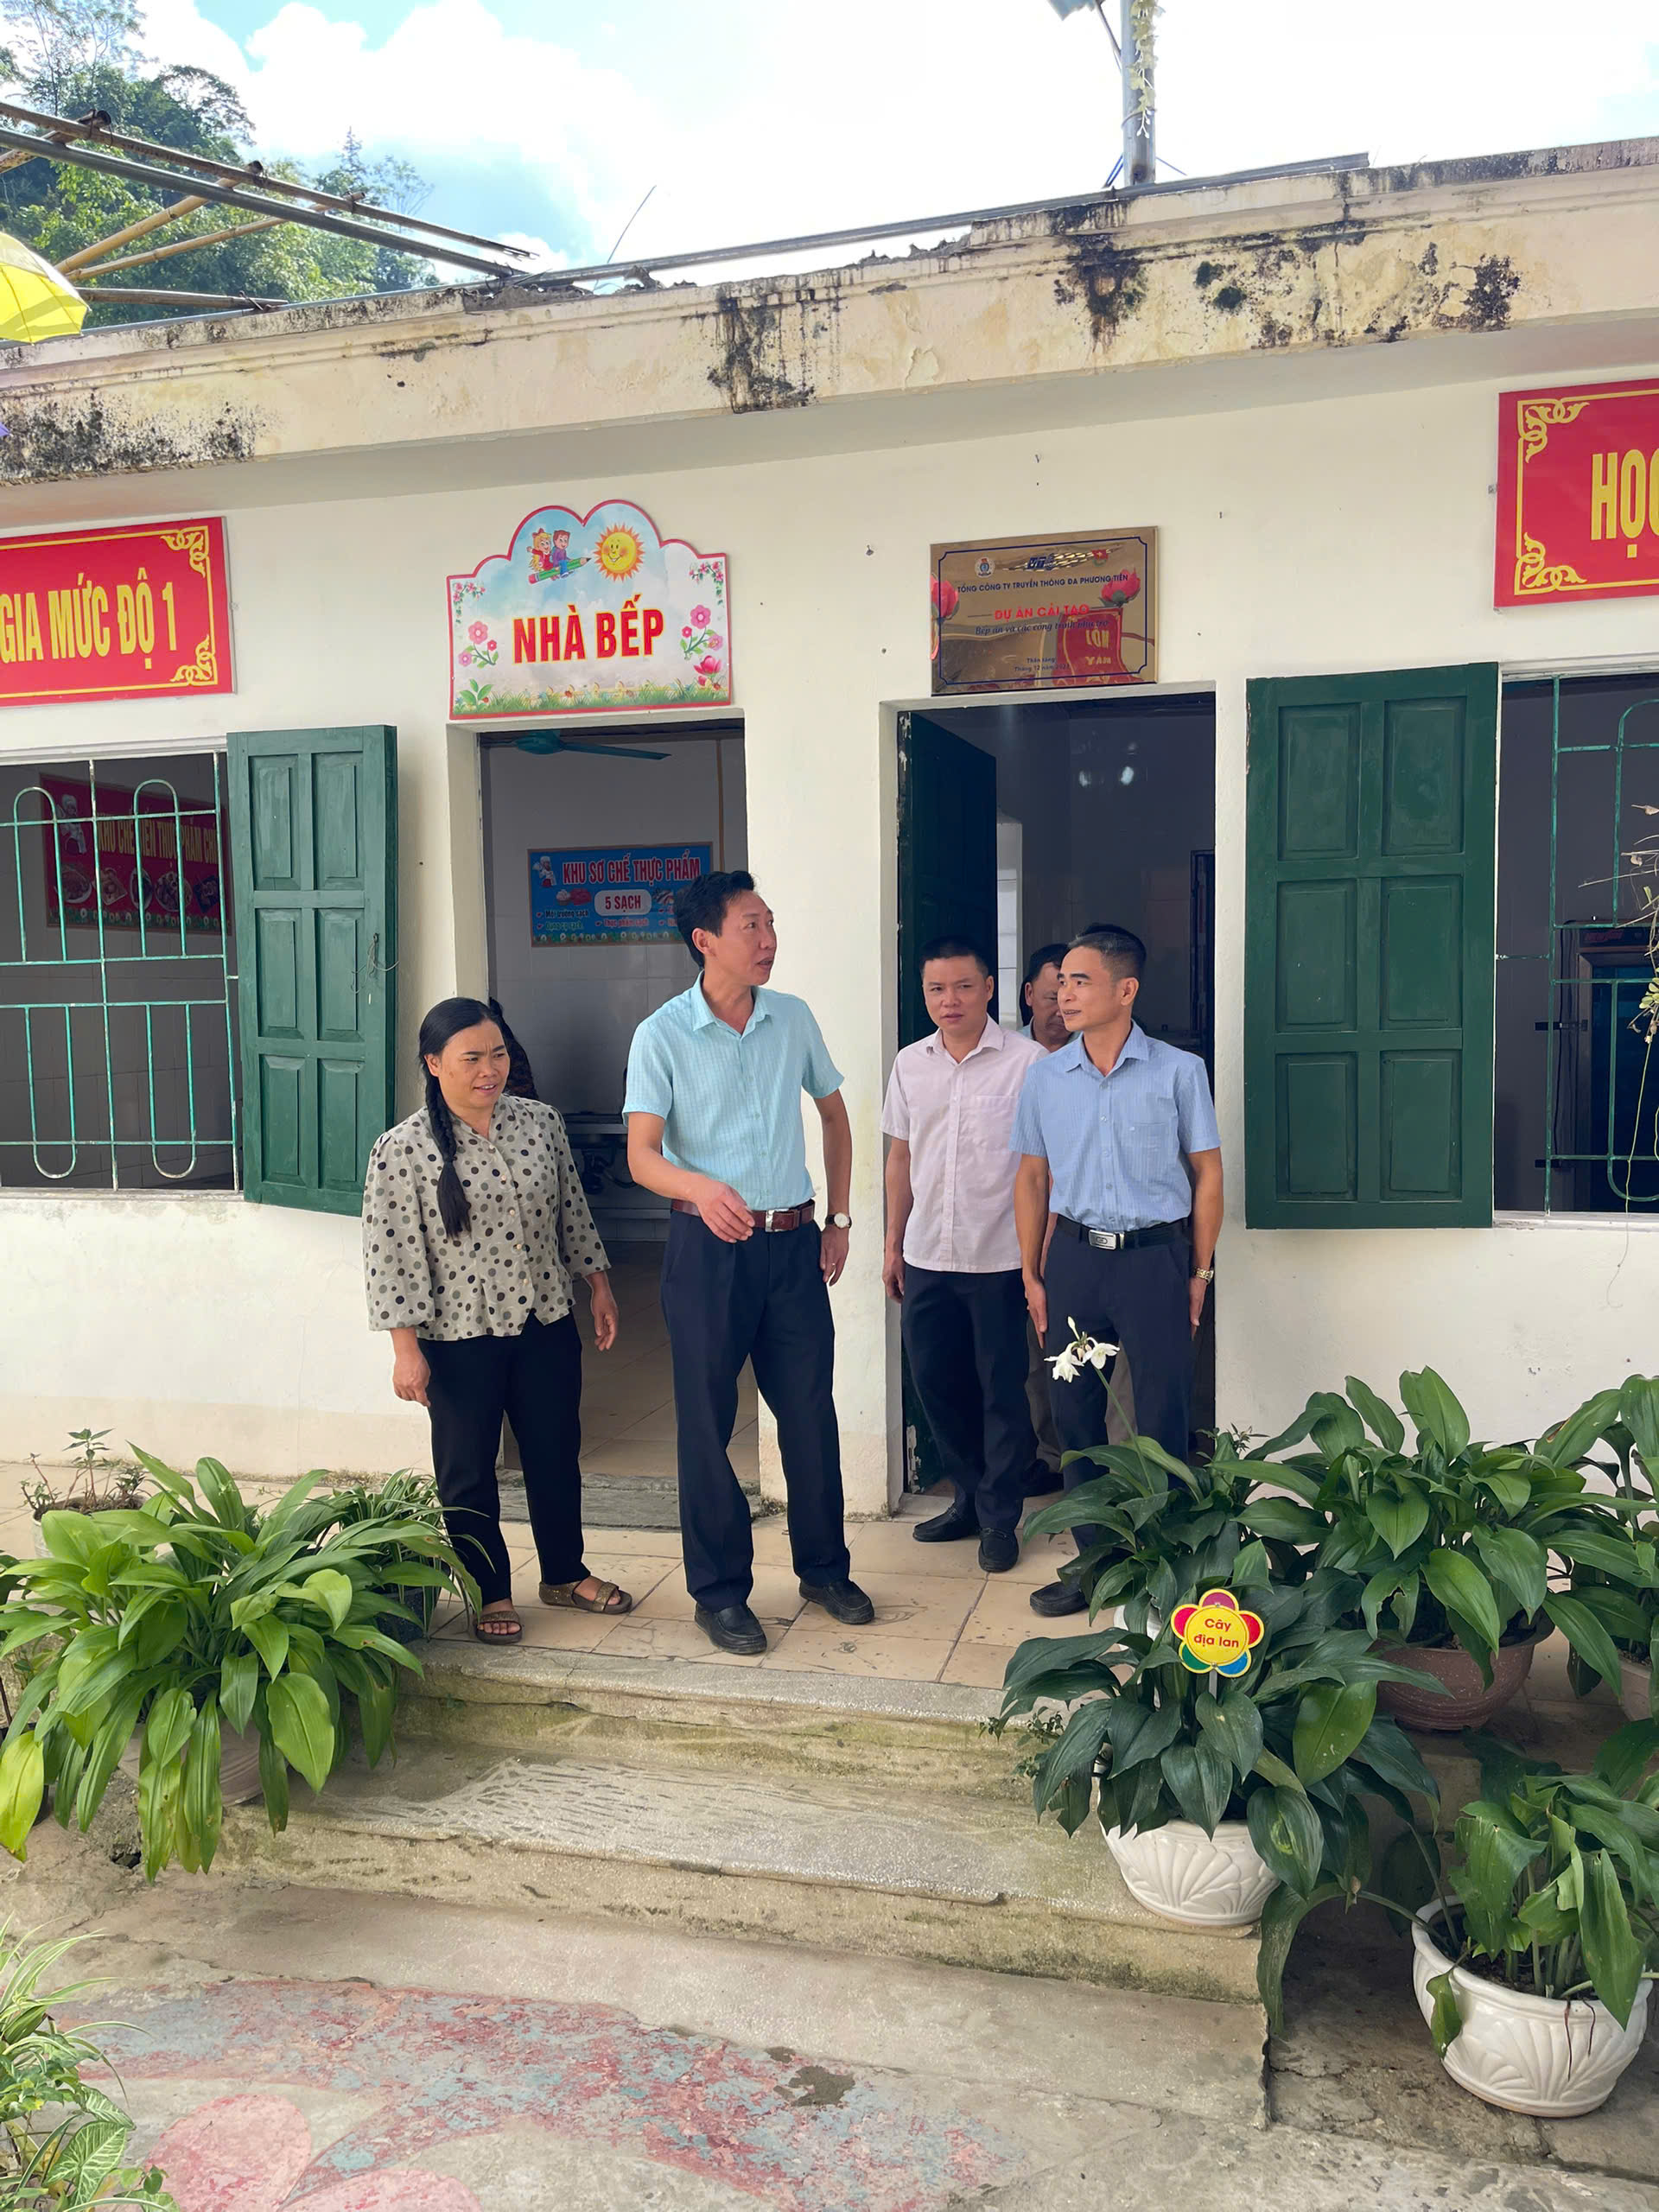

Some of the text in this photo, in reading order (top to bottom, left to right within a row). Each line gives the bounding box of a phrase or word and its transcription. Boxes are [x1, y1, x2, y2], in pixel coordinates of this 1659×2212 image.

[979, 582, 1001, 592] CÔNG
[1002, 582, 1011, 590] TY
[1013, 578, 1039, 588] TRUYỀN
[1040, 578, 1065, 588] THÔNG
[1080, 575, 1111, 584] PHƯƠNG
[0, 567, 176, 669] GIA MỨC ĐỘ 1
[995, 608, 1011, 622] DỰ
[1015, 605, 1033, 619] ÁN
[1037, 602, 1059, 616] CẢI
[512, 593, 664, 665] NHÀ BẾP
[563, 861, 586, 884] KHU
[589, 859, 604, 883] SƠ
[608, 852, 631, 882] CHẾ
[634, 857, 663, 885] THỰC
[605, 894, 641, 912] 5 SẠCH
[1204, 1618, 1231, 1631] Cây
[1193, 1634, 1239, 1648] địa lan
